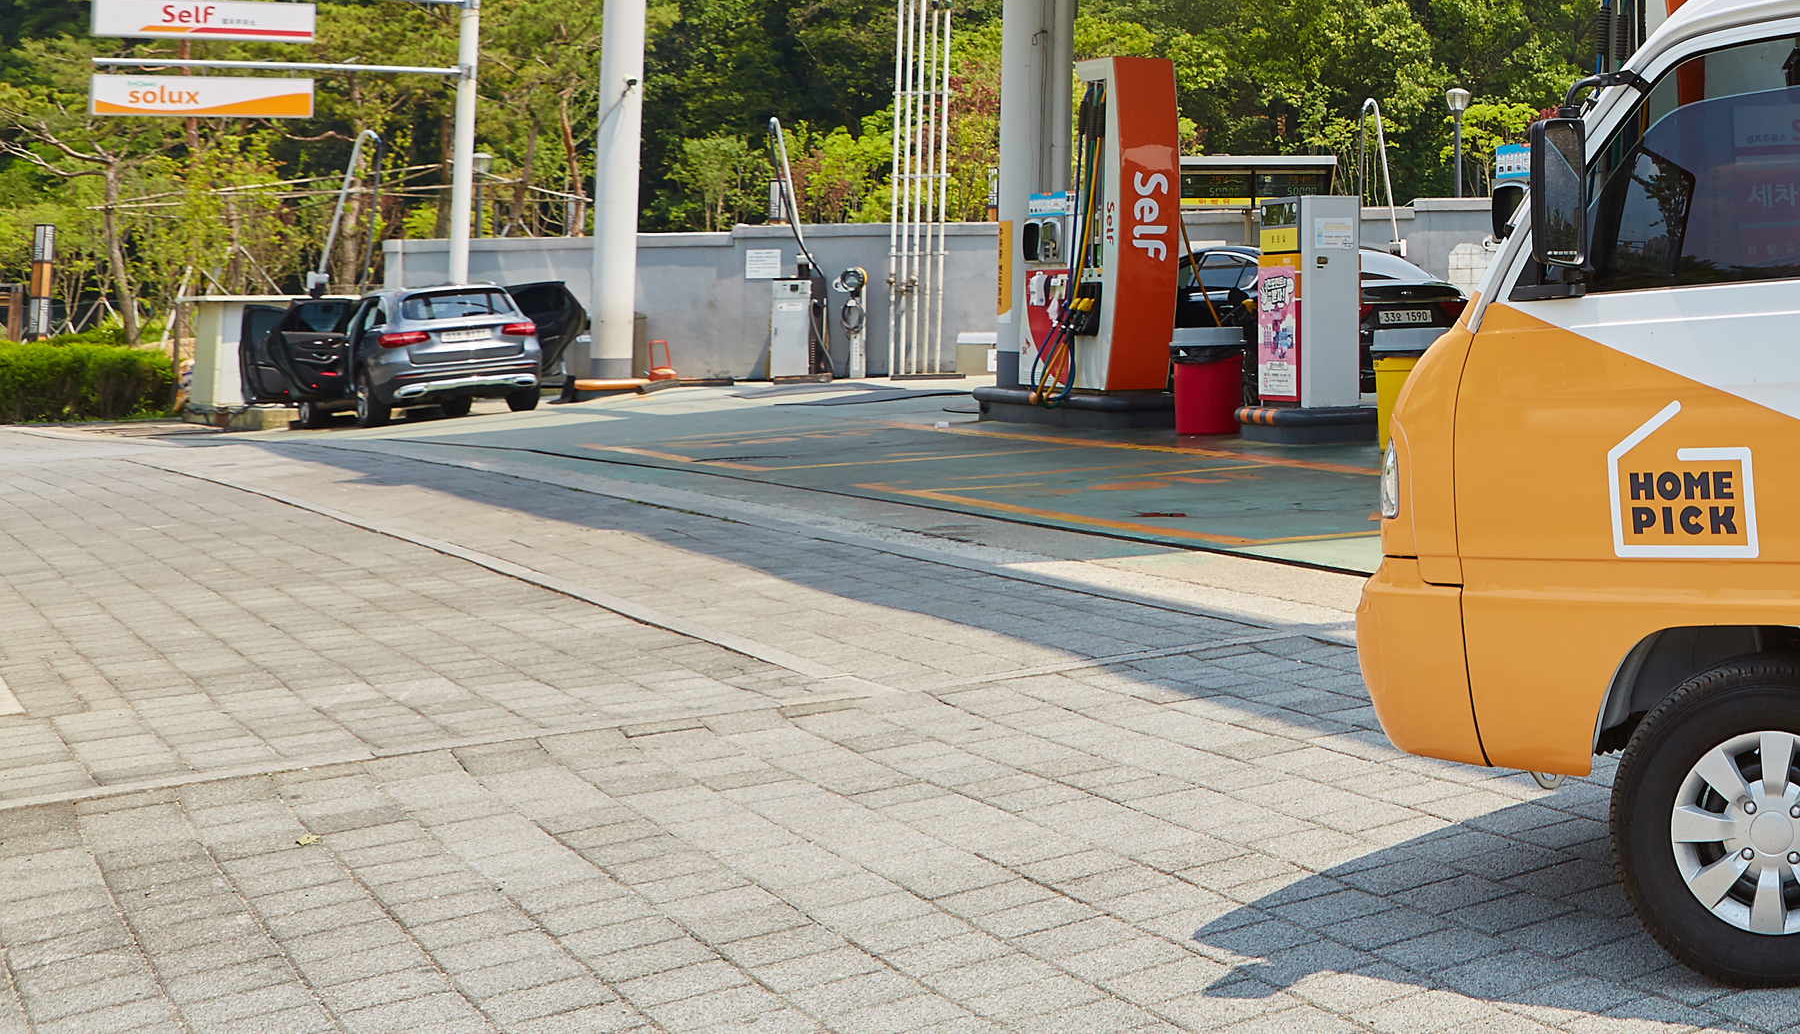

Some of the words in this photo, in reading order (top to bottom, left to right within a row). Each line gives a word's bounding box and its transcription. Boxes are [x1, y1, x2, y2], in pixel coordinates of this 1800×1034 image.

[161, 4, 216, 24] Self
[128, 84, 199, 105] solux
[1106, 201, 1115, 246] Self
[1132, 171, 1169, 262] Self
[1406, 311, 1428, 322] 1590
[1629, 471, 1735, 501] HOME
[1631, 505, 1738, 535] PICK
